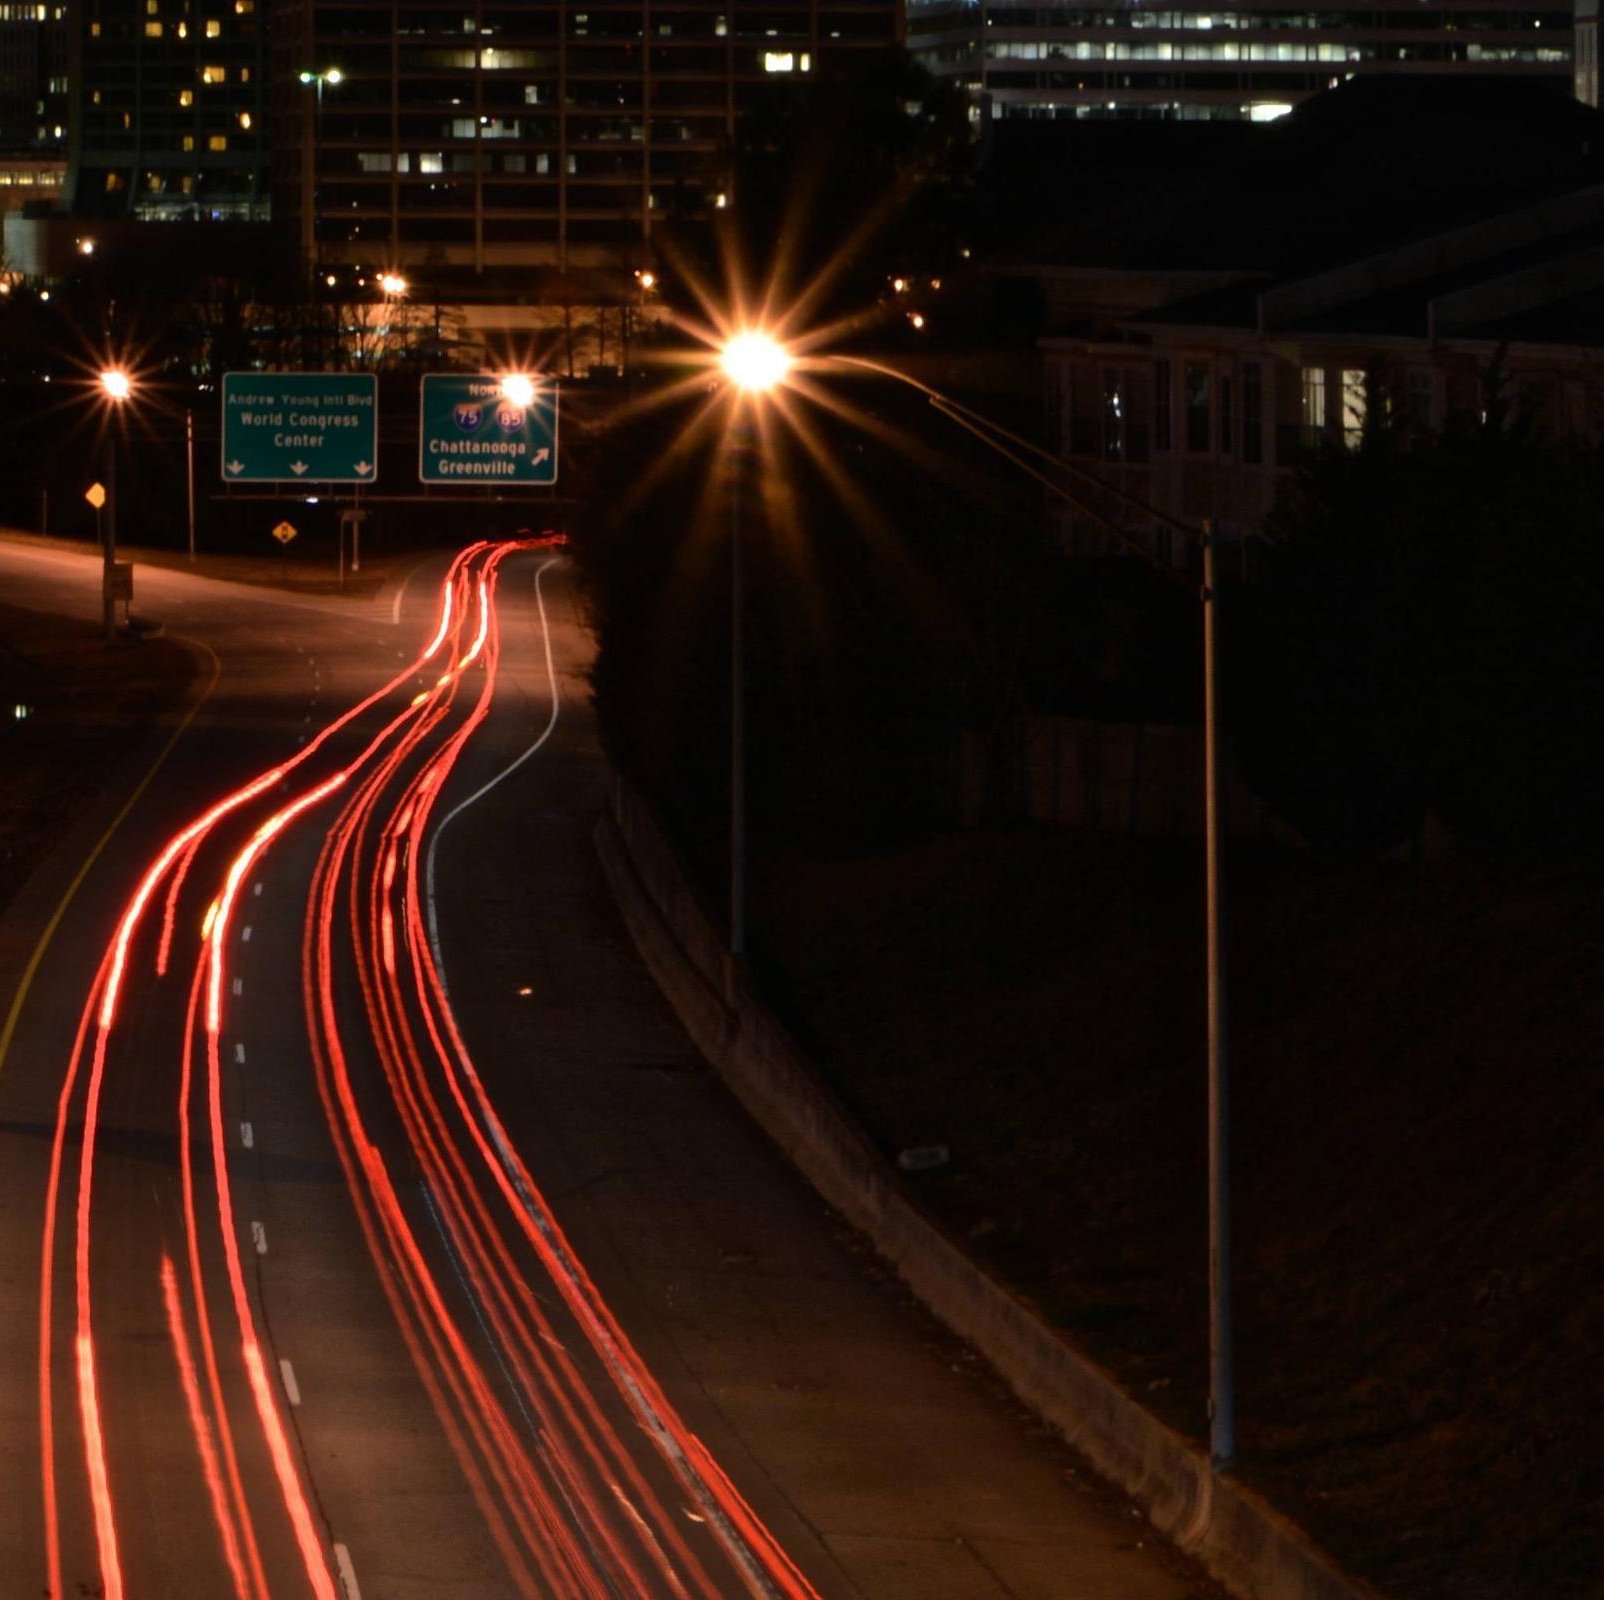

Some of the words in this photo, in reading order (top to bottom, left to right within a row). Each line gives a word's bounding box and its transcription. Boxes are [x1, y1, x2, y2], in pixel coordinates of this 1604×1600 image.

[228, 393, 275, 405] Andrew
[281, 393, 319, 408] Young
[347, 393, 373, 406] Blvd
[241, 412, 283, 426] World
[289, 412, 359, 430] Congress
[458, 410, 478, 425] 75
[500, 411, 522, 426] 85
[274, 433, 324, 447] Center
[429, 439, 526, 457] Chattanooga
[438, 459, 516, 475] Greenville
